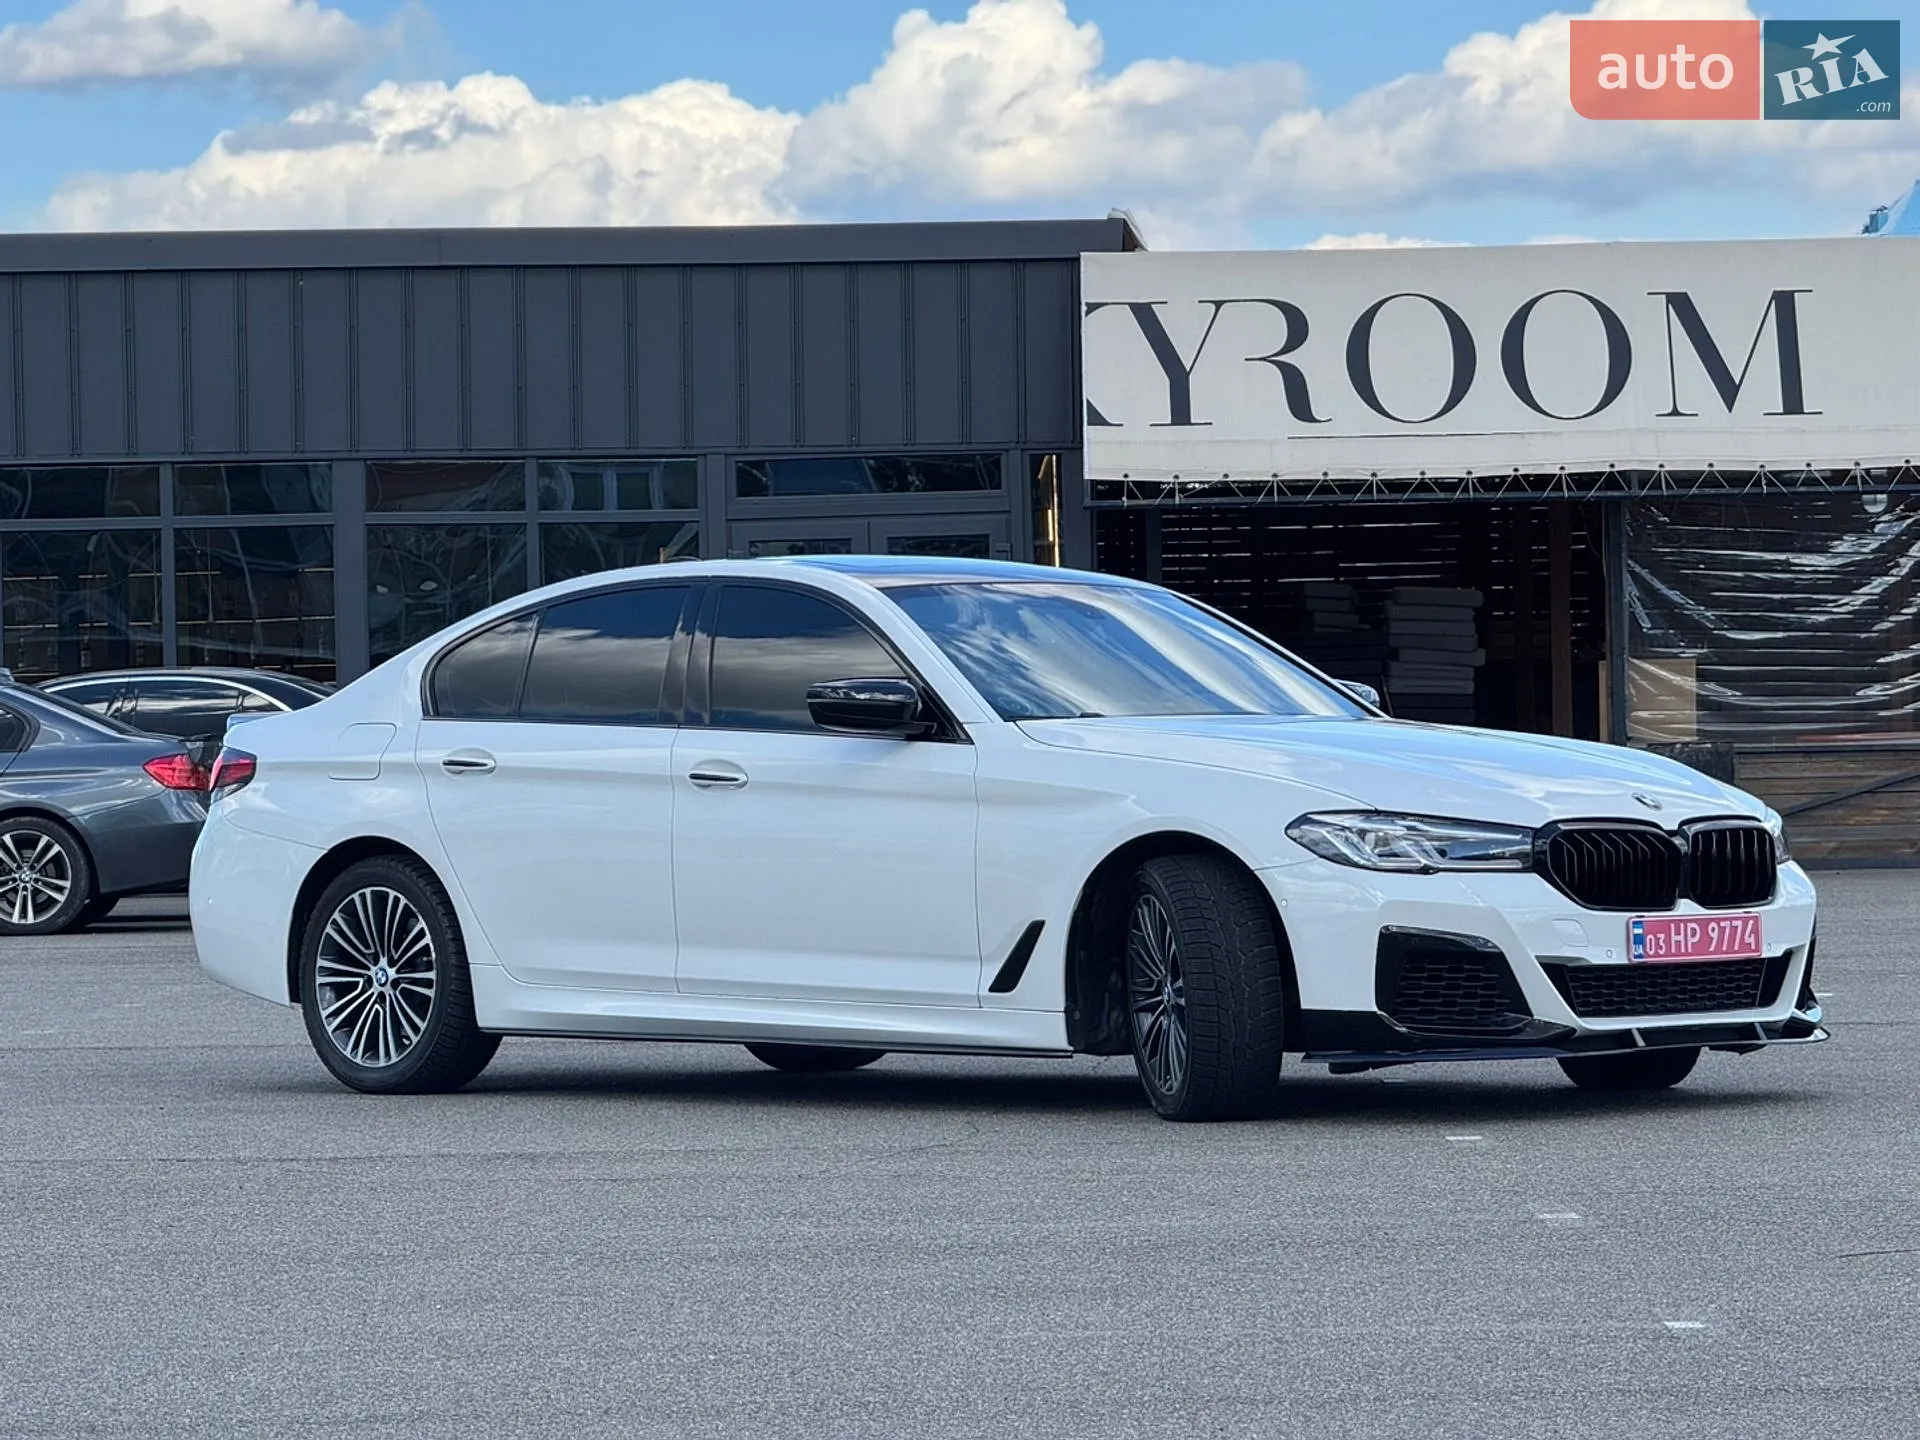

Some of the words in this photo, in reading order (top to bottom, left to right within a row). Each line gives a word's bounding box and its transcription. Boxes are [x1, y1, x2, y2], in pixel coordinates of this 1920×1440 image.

[1646, 933, 1666, 955] 03
[1670, 922, 1700, 953] HP
[1707, 919, 1756, 952] 9774
